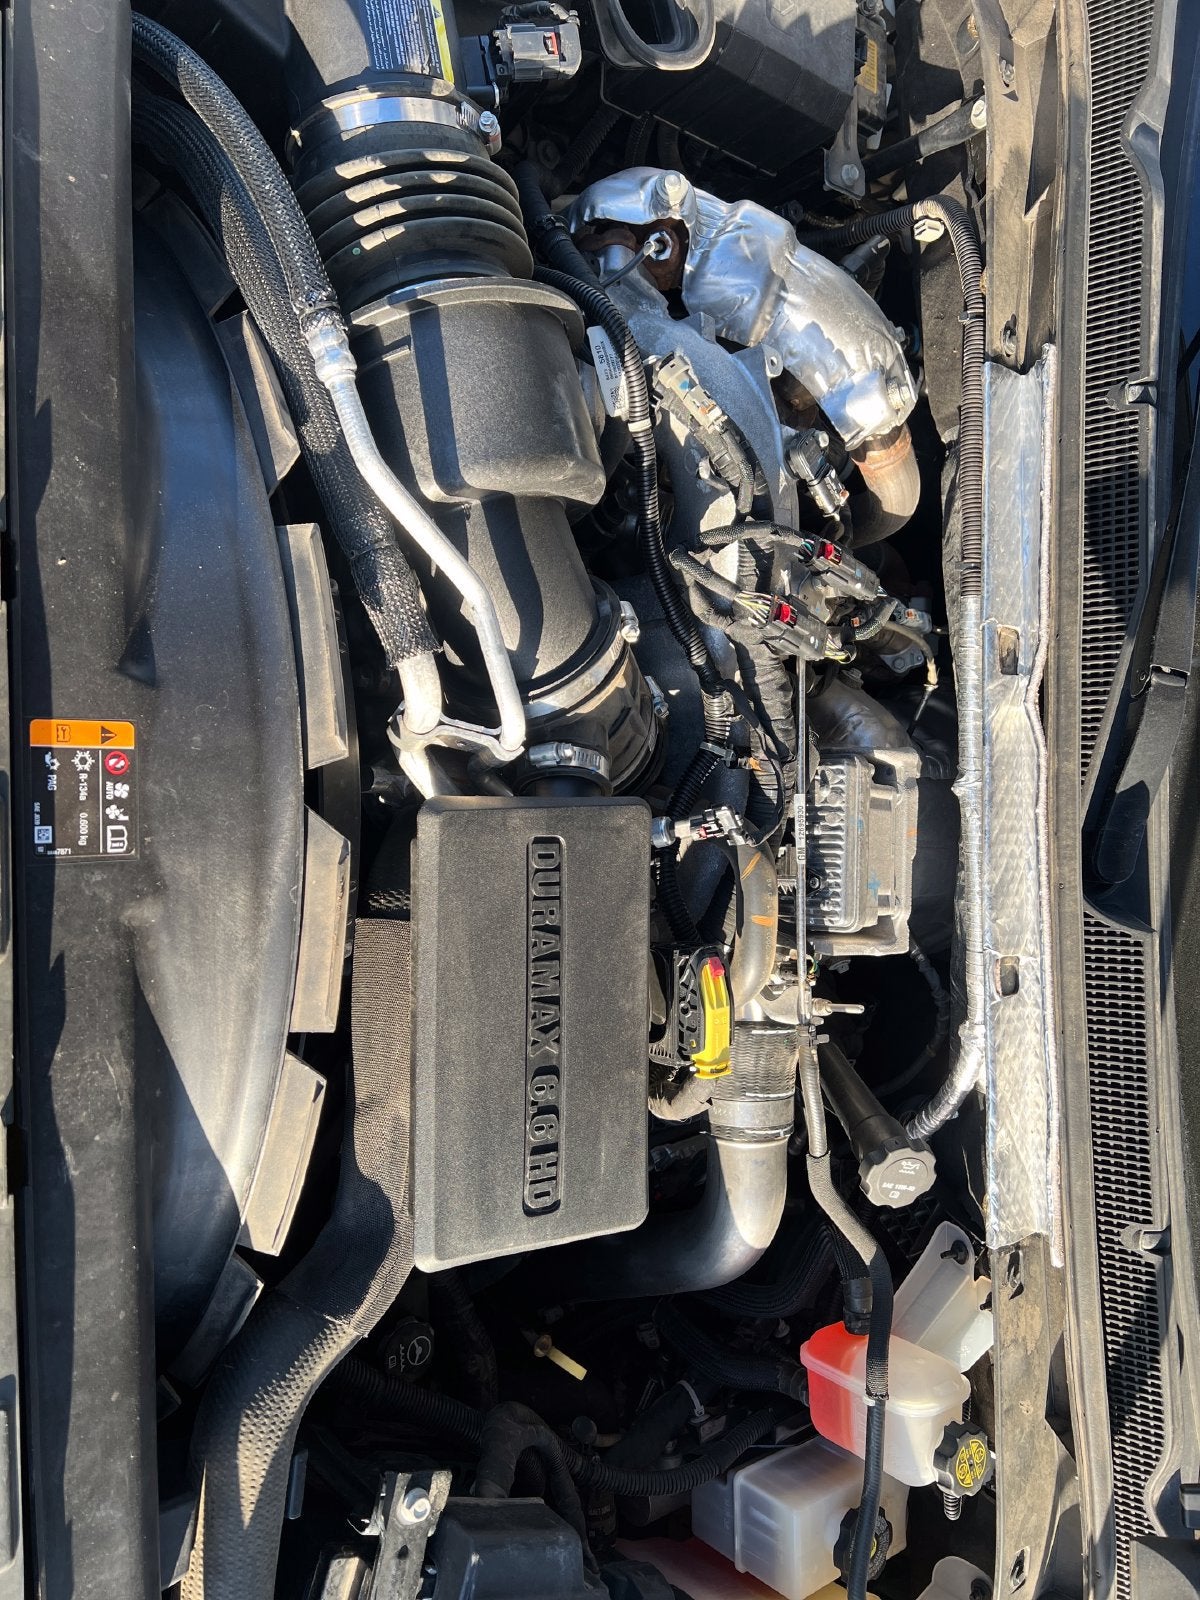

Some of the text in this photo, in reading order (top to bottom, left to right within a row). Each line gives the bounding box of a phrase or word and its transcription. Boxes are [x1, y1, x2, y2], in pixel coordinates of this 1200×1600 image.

[595, 345, 605, 364] 5810
[47, 774, 57, 791] PAG
[105, 781, 114, 800] AUTO
[78, 773, 88, 846] R-134a 0.600 kg
[797, 847, 806, 861] GM
[525, 843, 561, 1209] DURAMAX 6.6 HD
